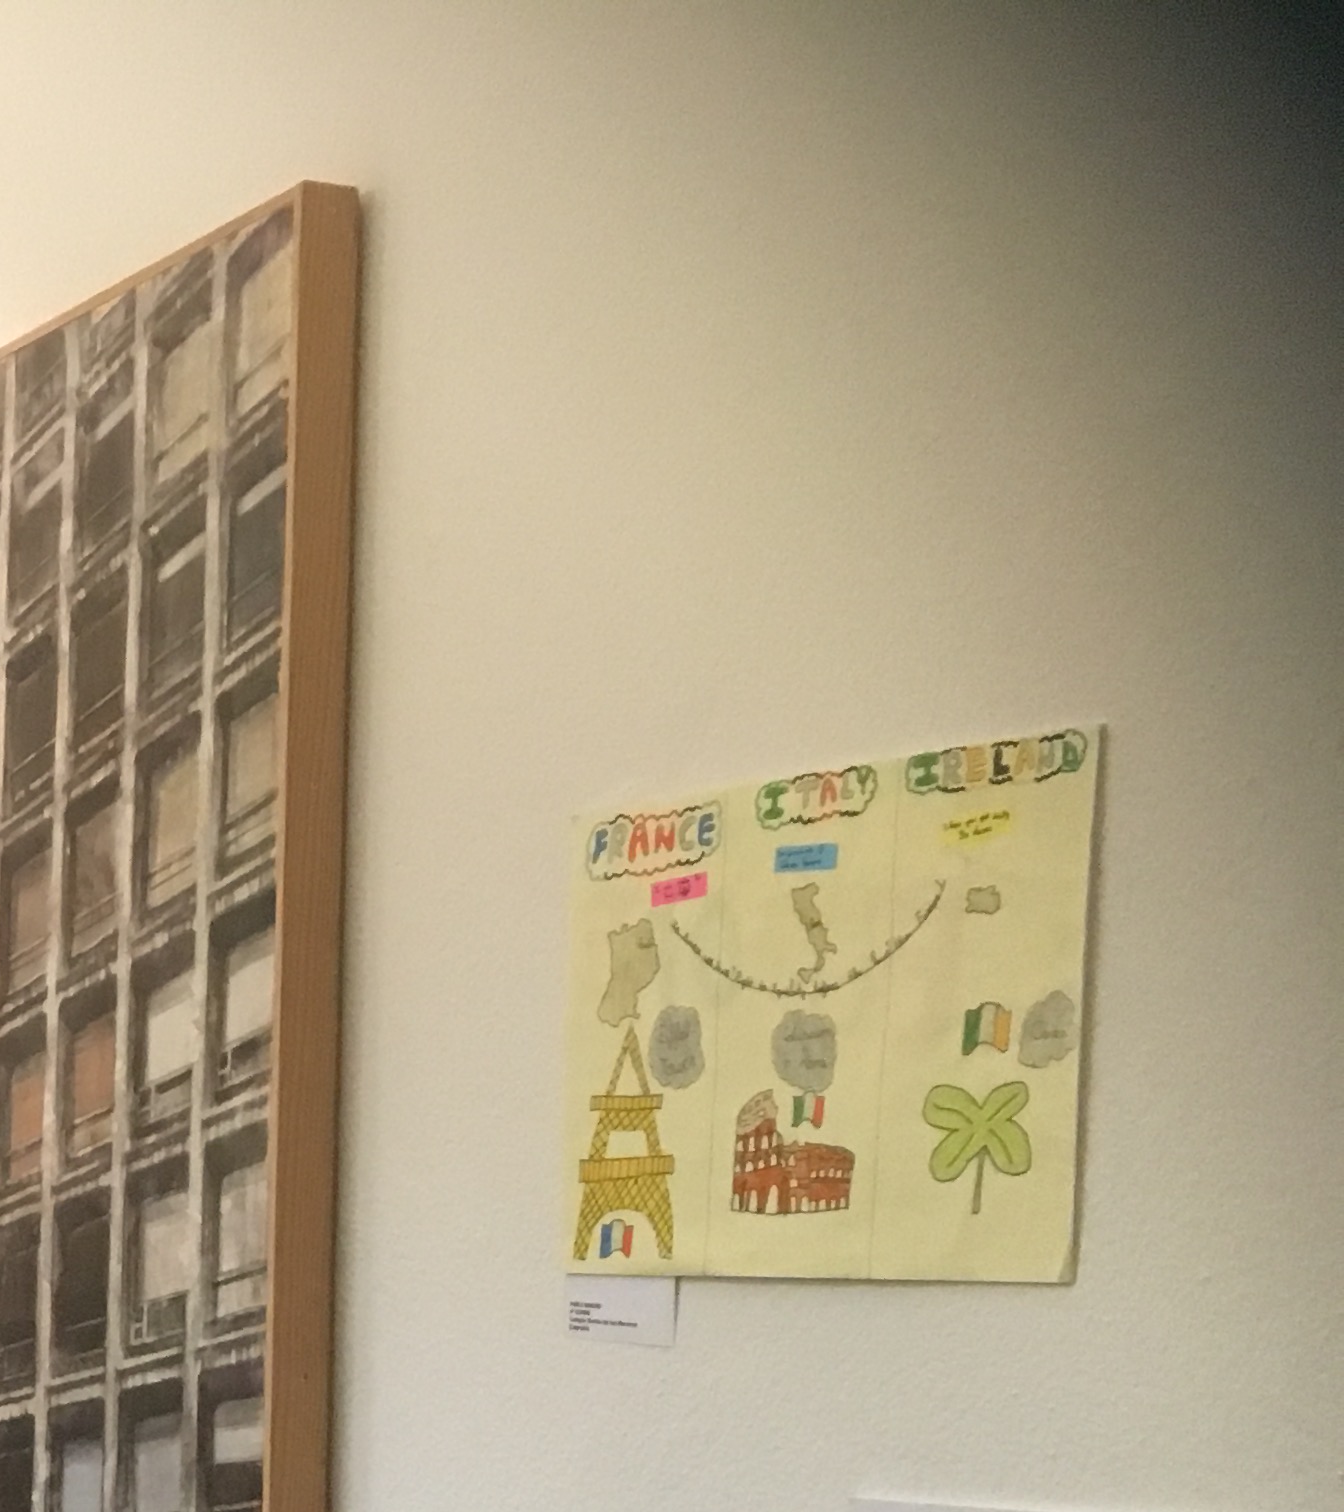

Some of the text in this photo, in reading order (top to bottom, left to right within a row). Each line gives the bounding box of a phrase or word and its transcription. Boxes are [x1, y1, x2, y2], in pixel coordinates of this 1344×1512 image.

[912, 736, 1083, 786] IRELAND
[762, 767, 874, 822] ITALY
[590, 812, 716, 866] FRANCE
